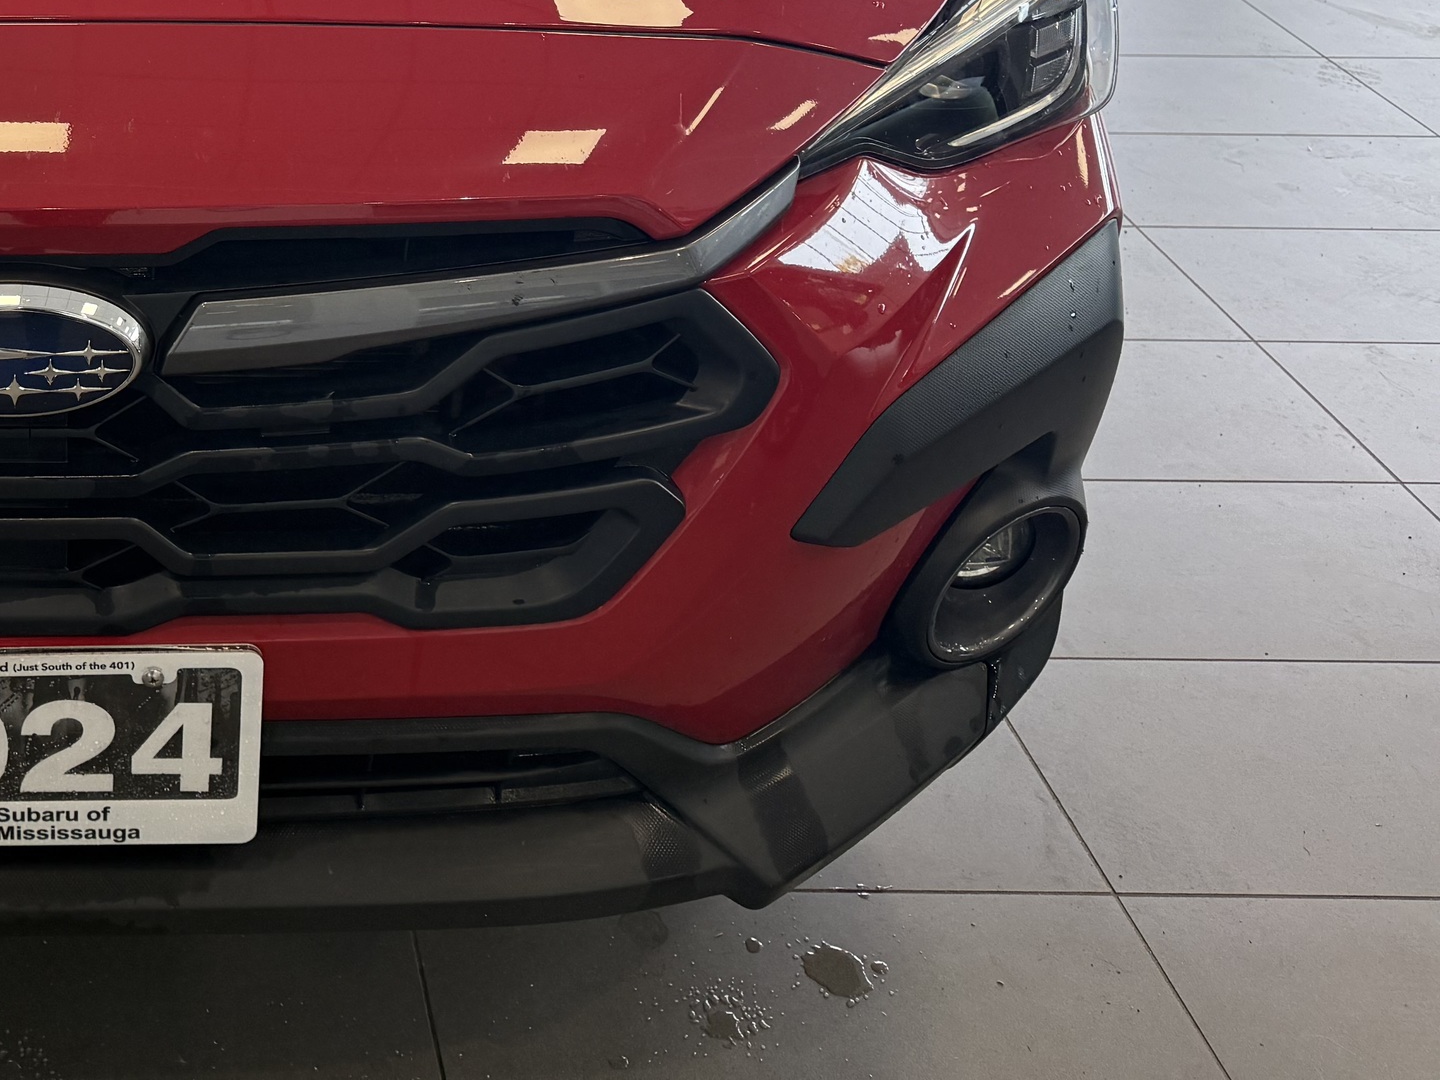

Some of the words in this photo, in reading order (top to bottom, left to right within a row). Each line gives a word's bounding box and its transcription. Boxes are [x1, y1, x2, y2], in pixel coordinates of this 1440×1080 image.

[13, 663, 39, 673] (Just
[41, 662, 72, 672] South
[75, 661, 87, 670] of
[89, 661, 107, 670] the
[109, 661, 135, 671] 401)
[87, 806, 111, 822] of
